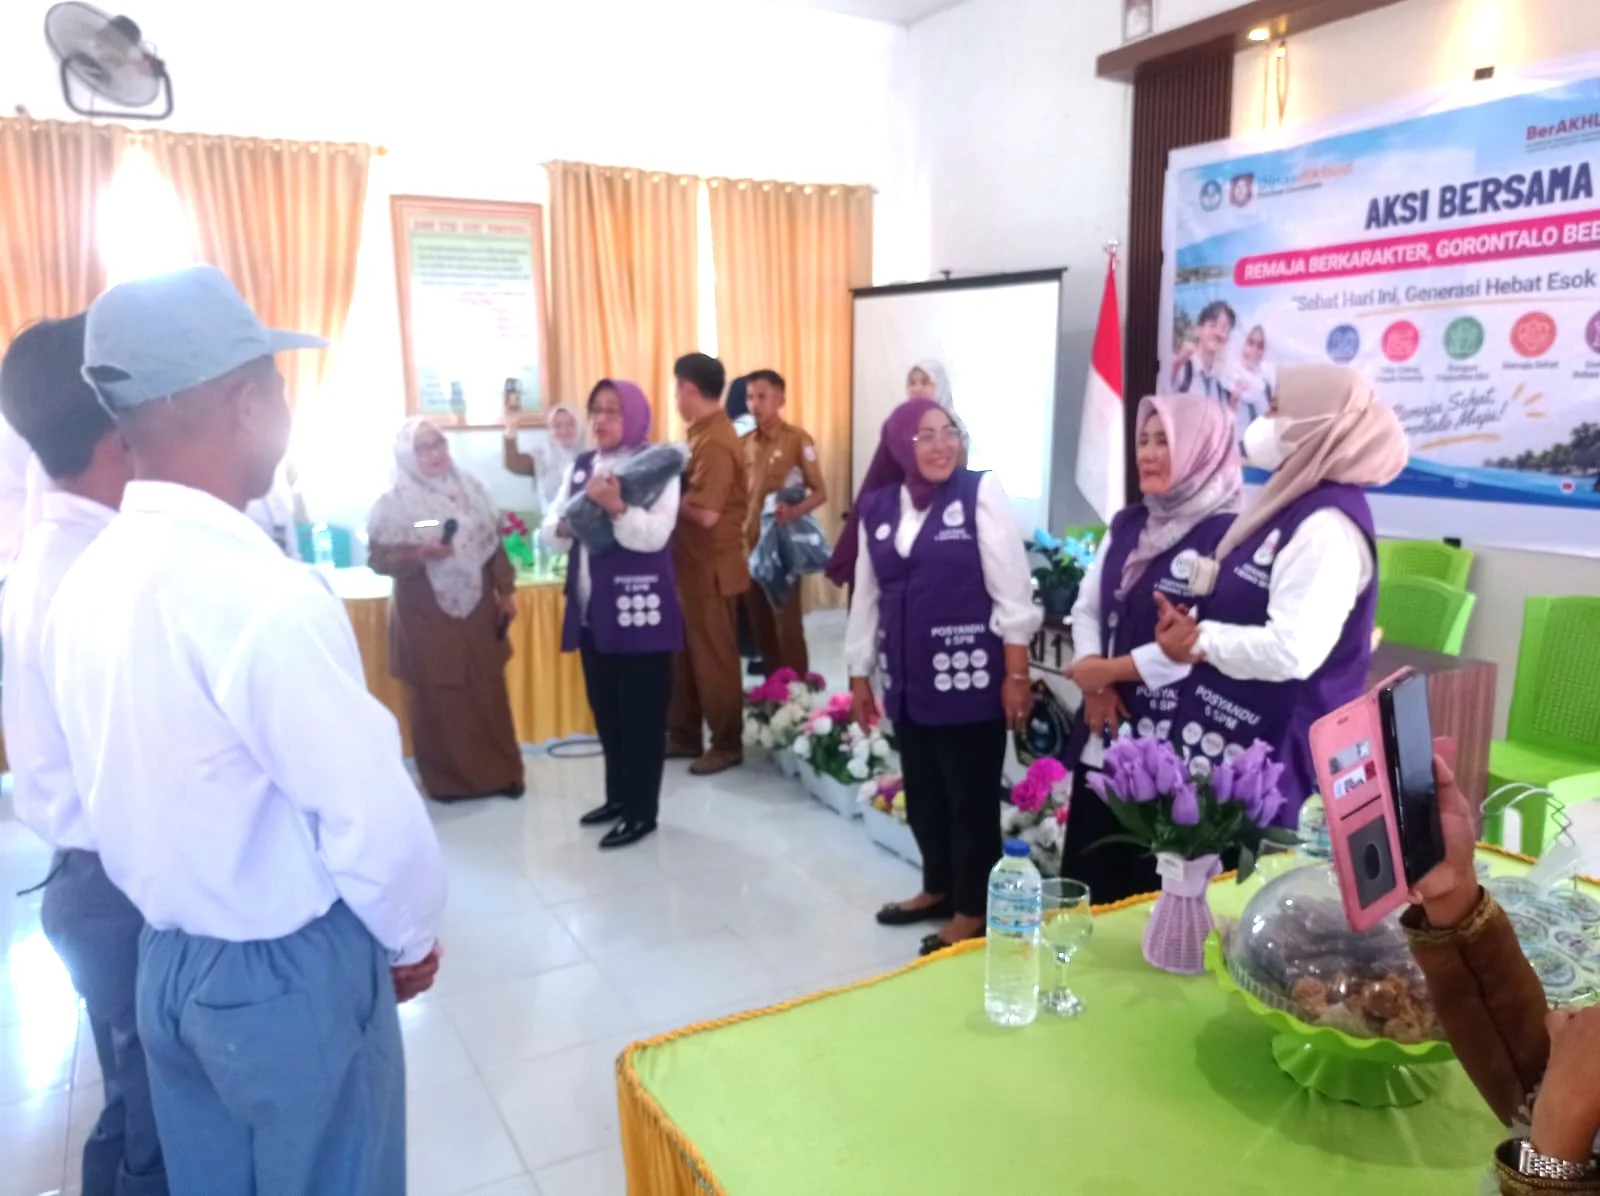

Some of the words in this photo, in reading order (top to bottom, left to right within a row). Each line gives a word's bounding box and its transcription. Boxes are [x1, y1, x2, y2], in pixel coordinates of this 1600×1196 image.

[1364, 189, 1430, 230] AKSI
[1438, 161, 1594, 219] BERSAMA
[1244, 257, 1307, 280] REMAJA
[1308, 242, 1432, 273] BERKARAKTER,
[1436, 226, 1558, 259] GORONTALO
[1342, 289, 1374, 307] Hari
[1405, 278, 1481, 301] Generasi
[1485, 274, 1542, 297] Hebat
[1547, 268, 1597, 289] Esok
